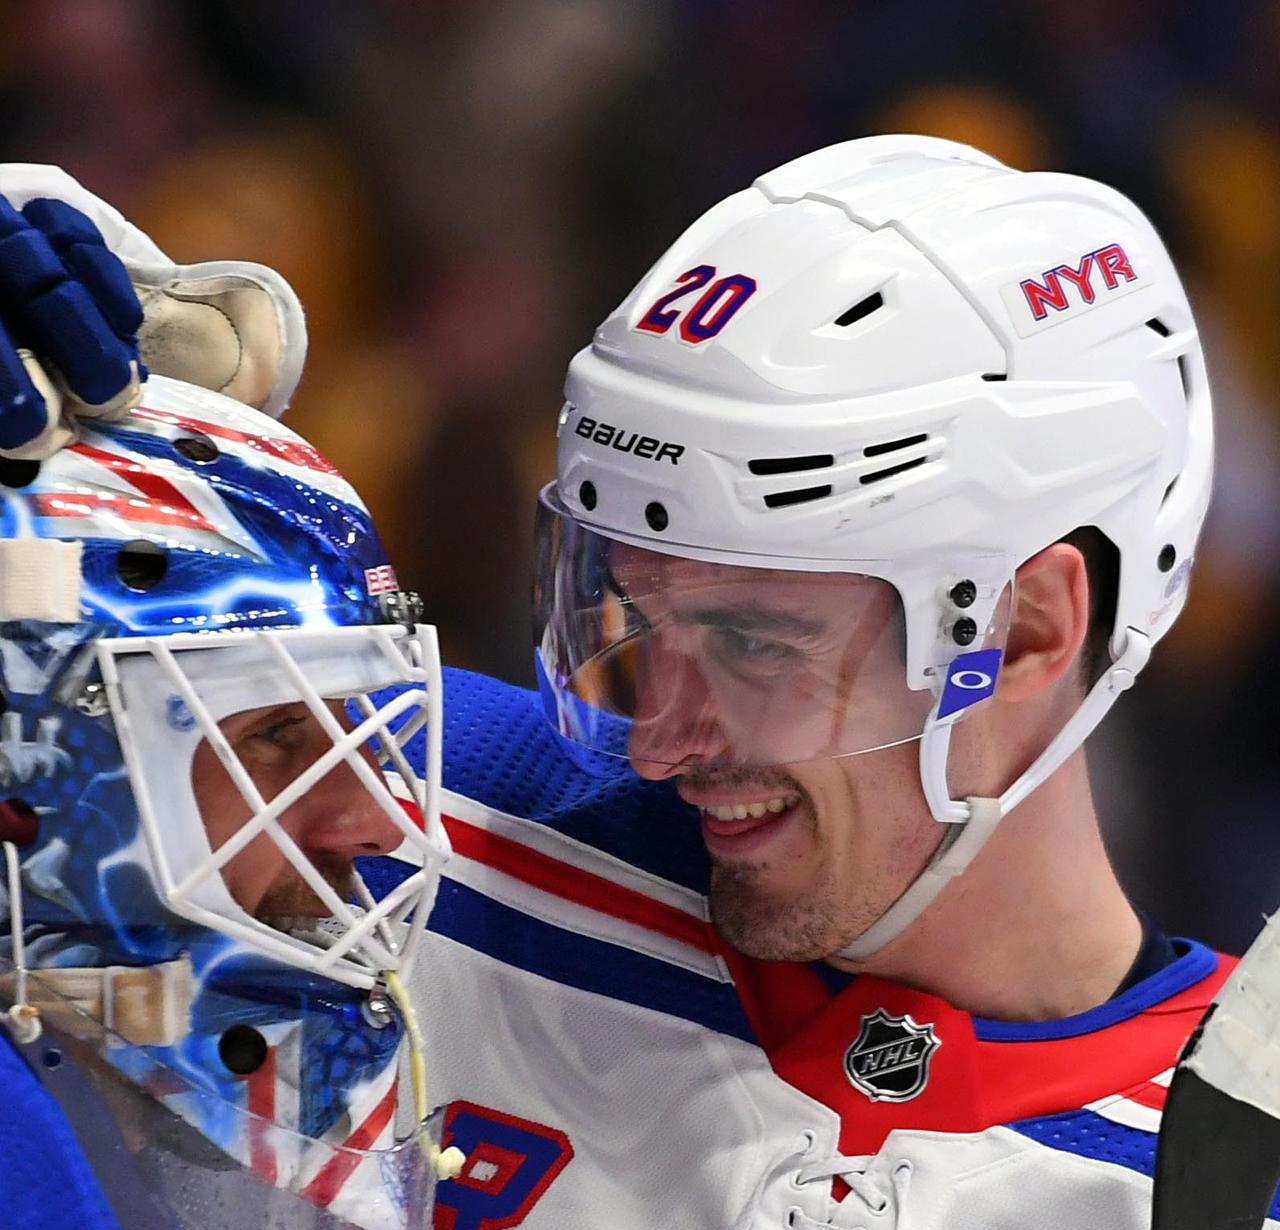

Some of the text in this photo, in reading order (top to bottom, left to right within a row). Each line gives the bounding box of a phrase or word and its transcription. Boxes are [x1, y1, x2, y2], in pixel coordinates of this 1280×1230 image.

[636, 264, 757, 347] 20
[1019, 243, 1138, 322] NYR
[860, 1042, 919, 1074] NHL
